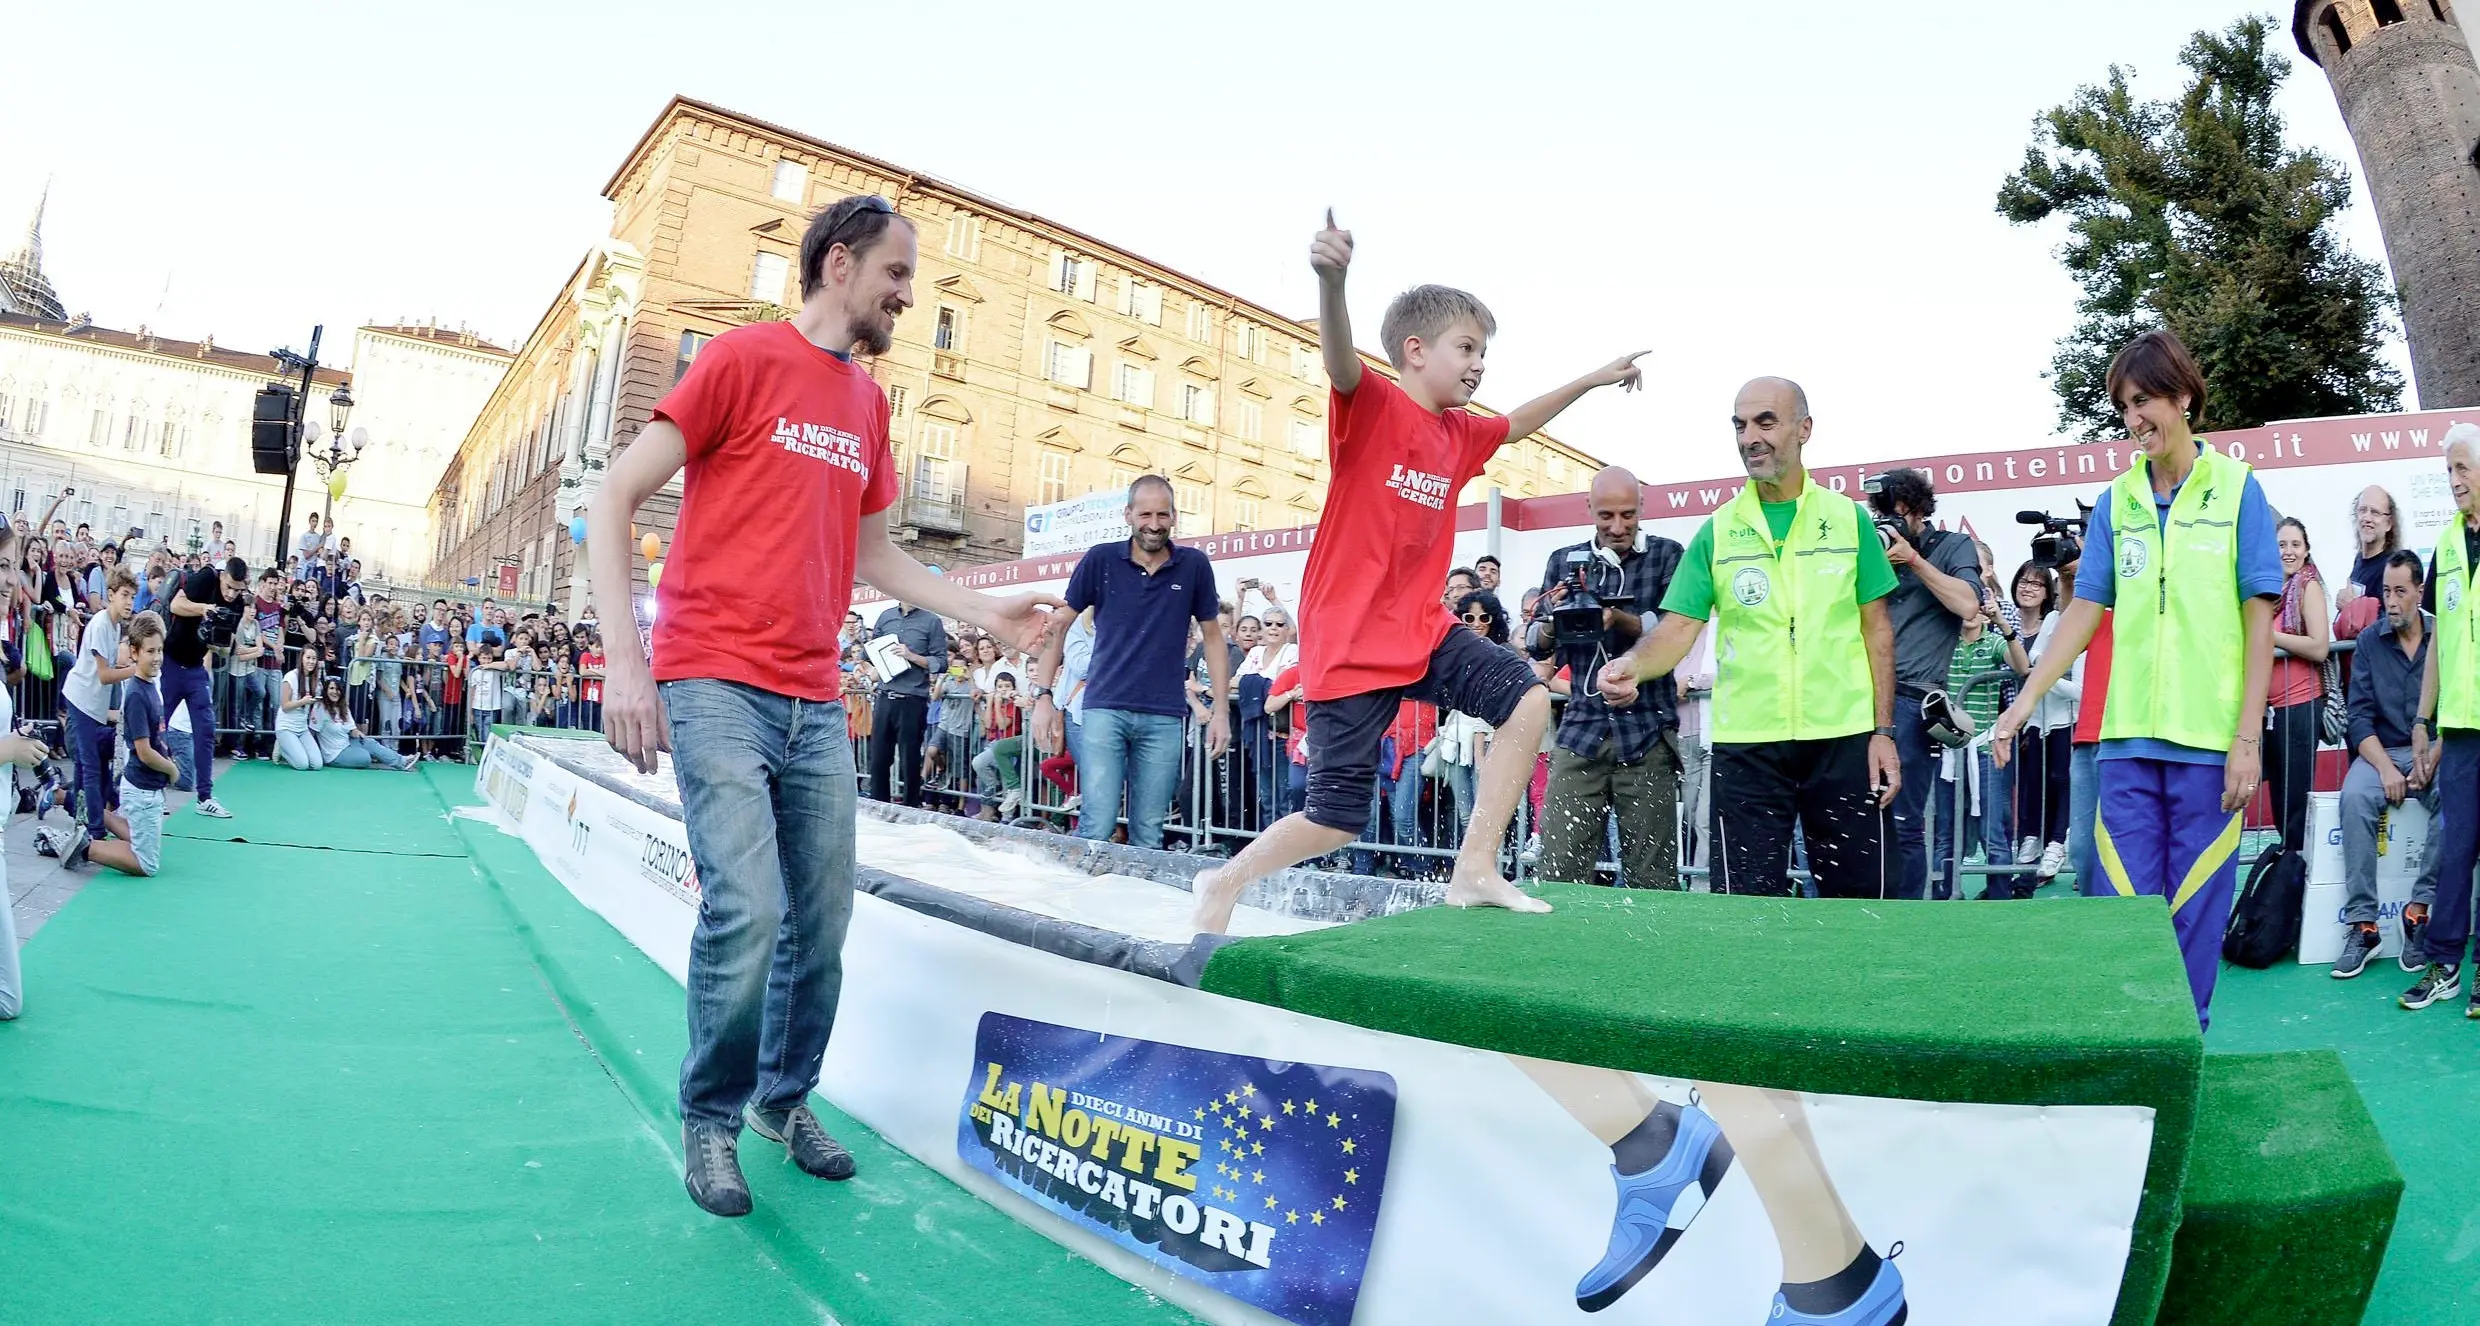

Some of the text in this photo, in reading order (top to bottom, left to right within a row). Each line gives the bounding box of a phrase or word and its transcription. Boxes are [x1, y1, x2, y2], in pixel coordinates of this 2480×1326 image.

[776, 416, 860, 458] LA NOTTE
[2351, 427, 2446, 452] www.
[1083, 525, 1130, 542] 011.2732
[978, 1062, 1201, 1191] LA NOTTE
[1070, 1091, 1203, 1141] DIECI ANNI DI
[969, 1102, 1276, 1269] DEI RICERCATORI
